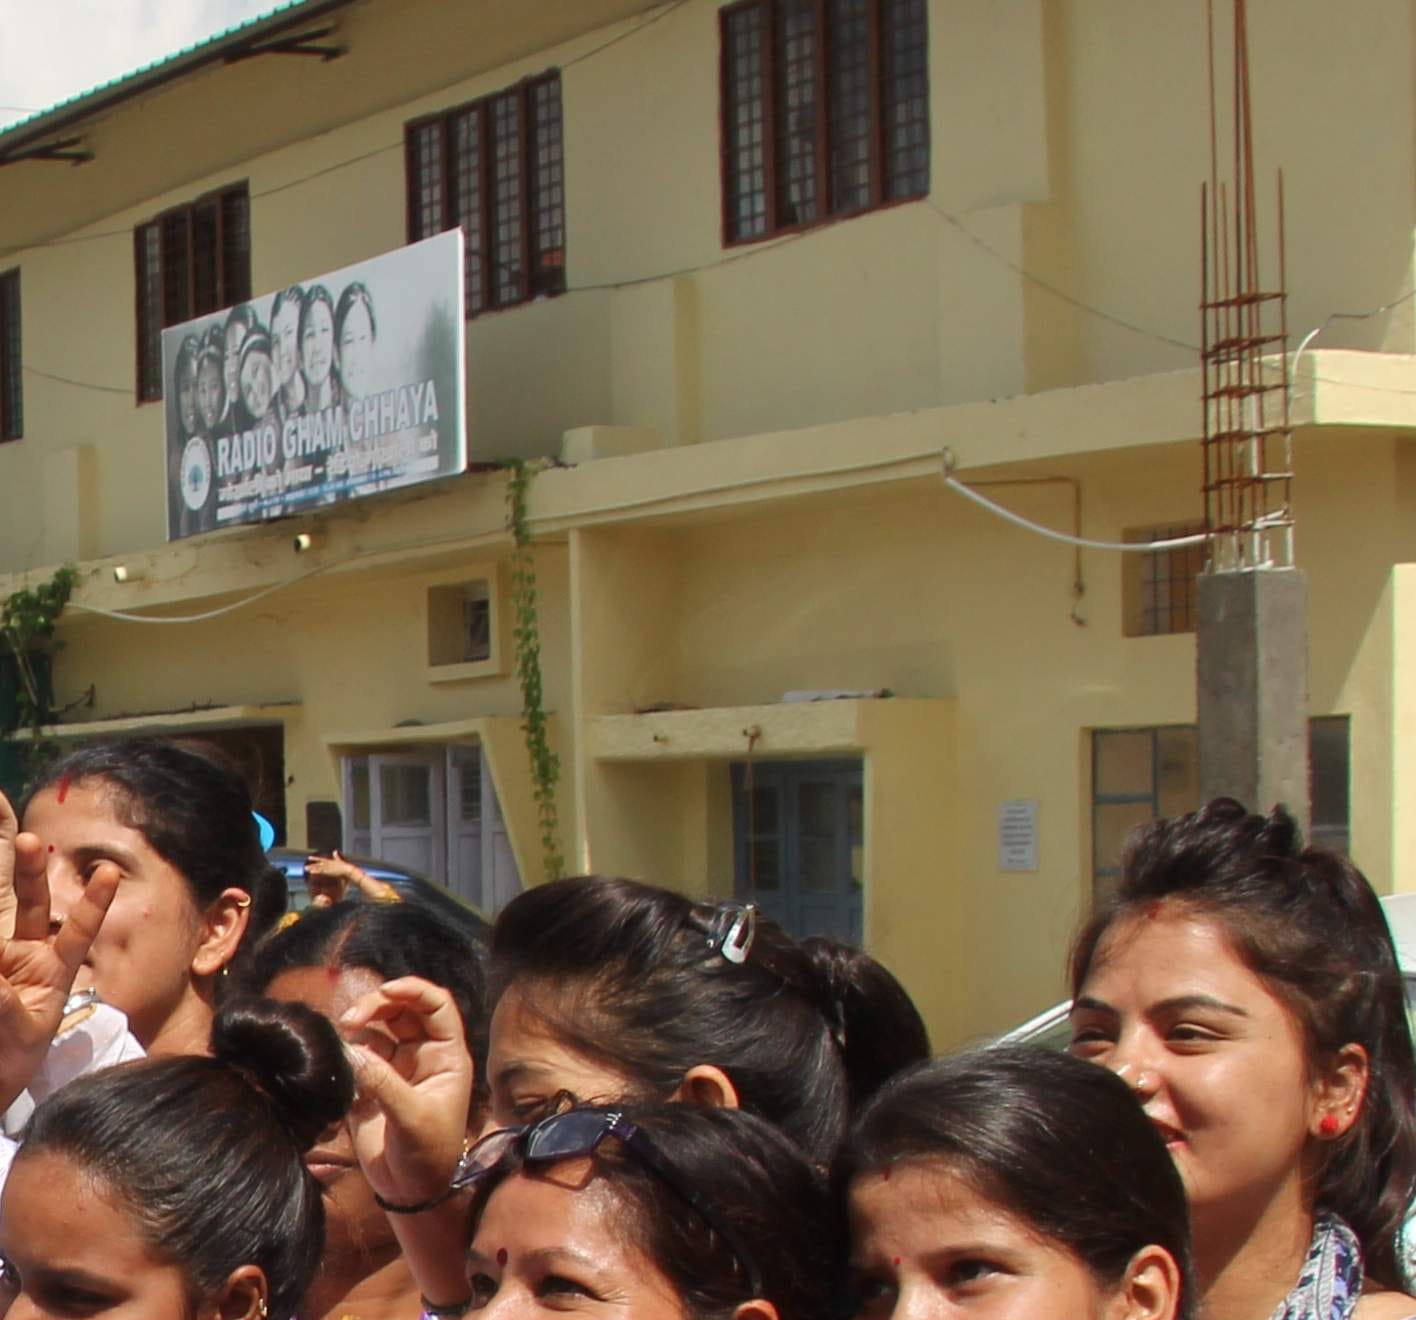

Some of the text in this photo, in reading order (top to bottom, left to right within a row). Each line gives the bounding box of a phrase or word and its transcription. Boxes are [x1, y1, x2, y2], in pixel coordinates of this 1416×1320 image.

[218, 425, 276, 477] RADIO
[282, 407, 344, 459] GHAM
[349, 379, 440, 442] CHHAYA
